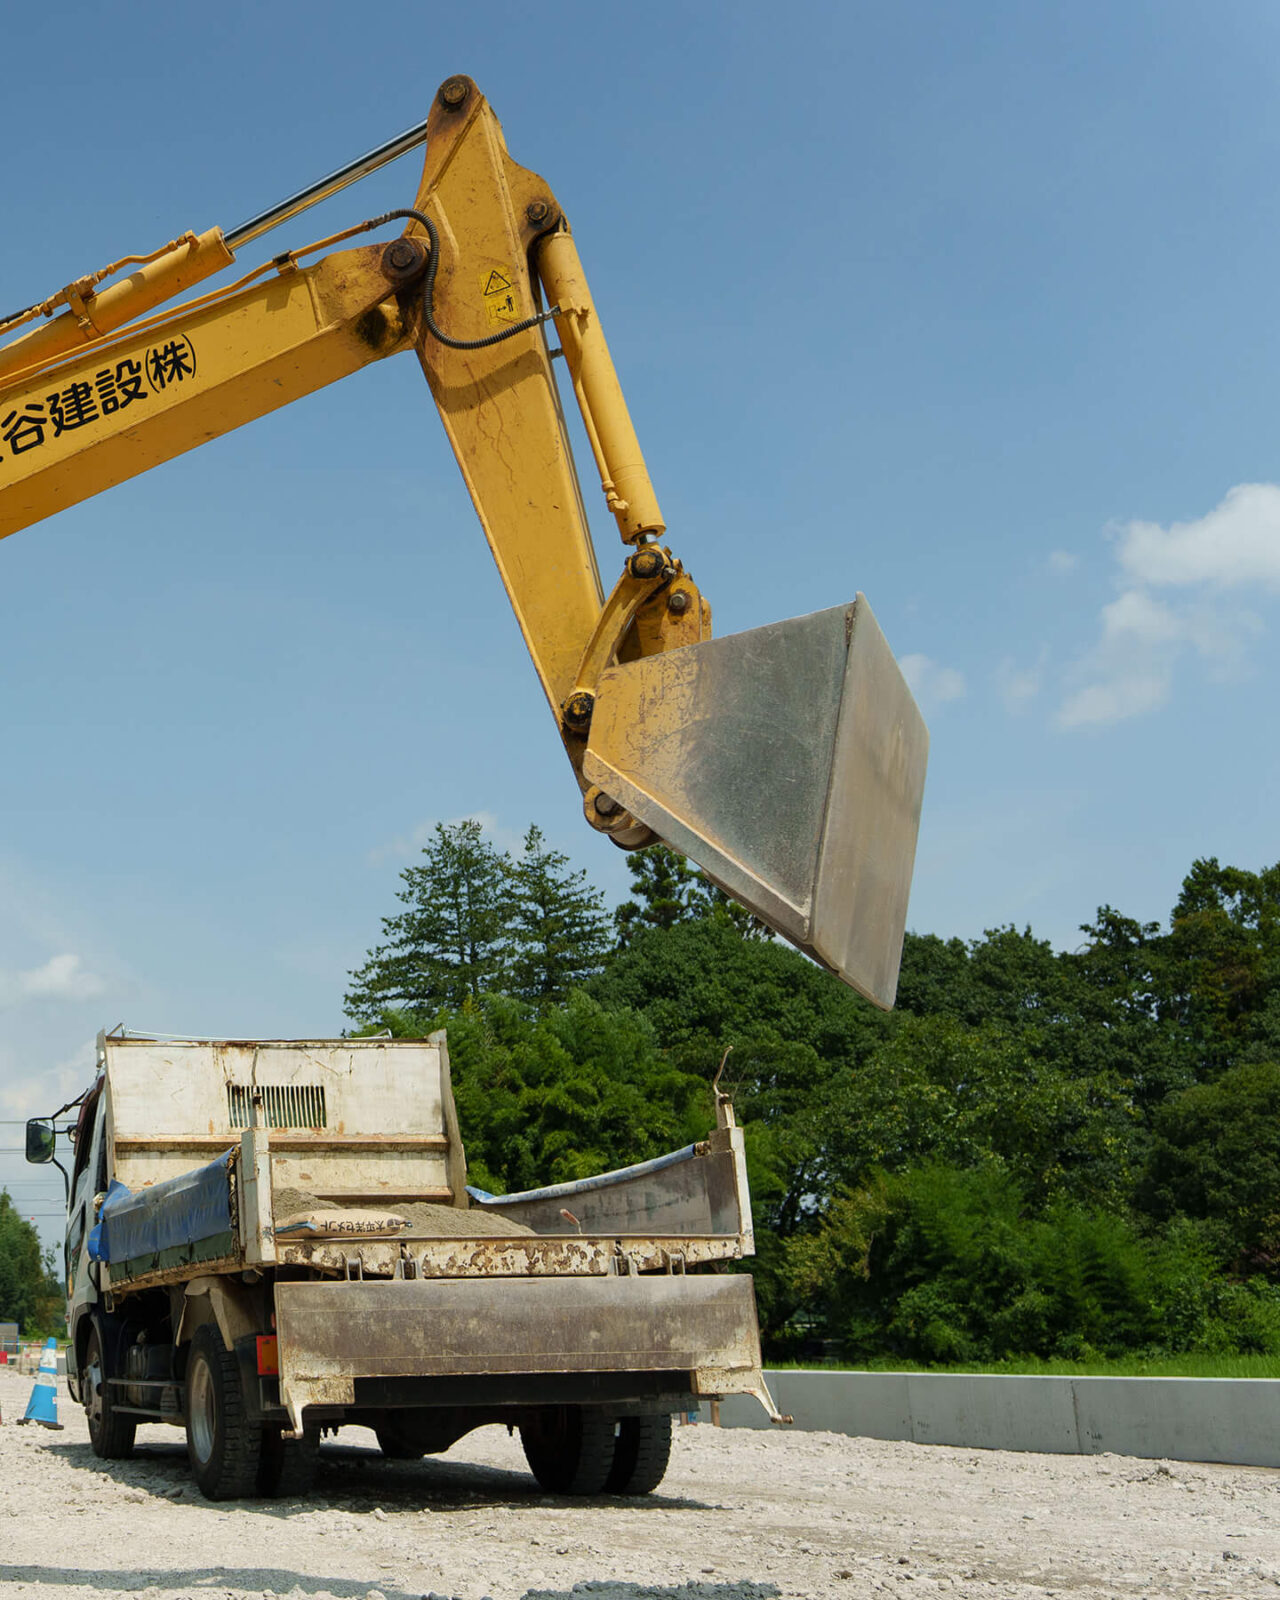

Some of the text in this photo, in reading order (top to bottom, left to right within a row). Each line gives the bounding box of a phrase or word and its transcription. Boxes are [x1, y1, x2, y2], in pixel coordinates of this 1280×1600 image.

[320, 1220, 385, 1232] 太平洋セメント
